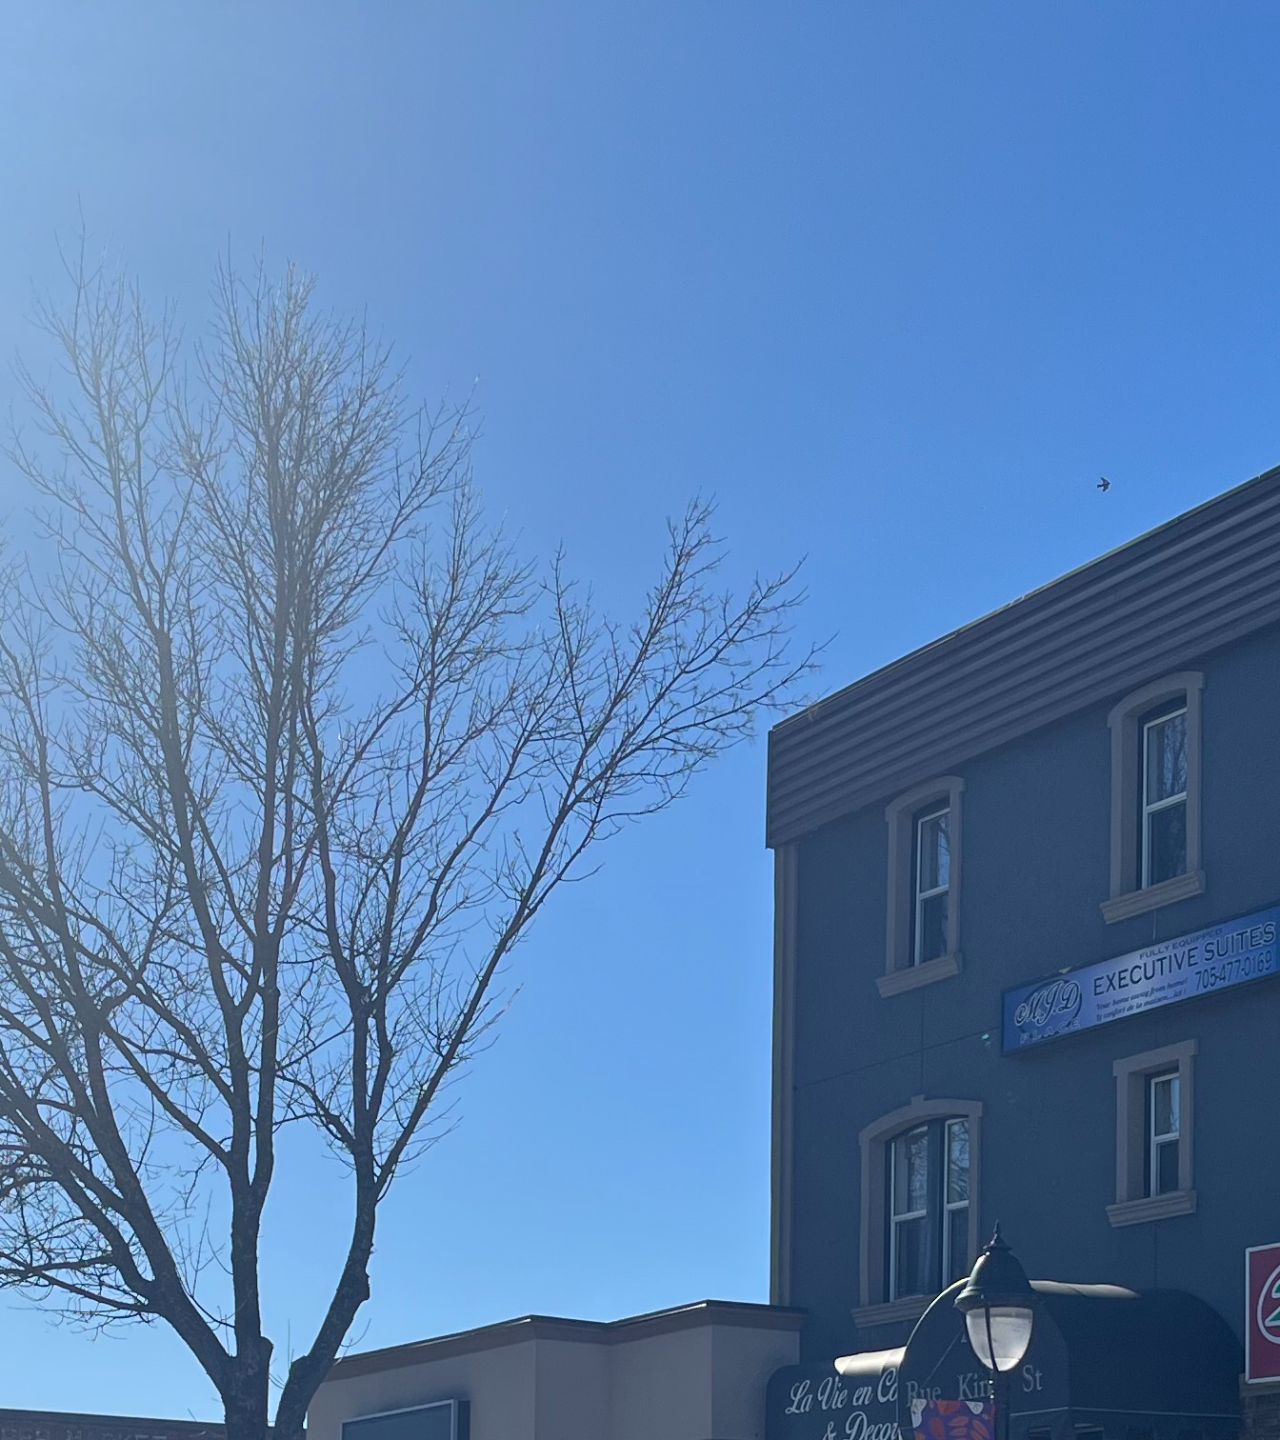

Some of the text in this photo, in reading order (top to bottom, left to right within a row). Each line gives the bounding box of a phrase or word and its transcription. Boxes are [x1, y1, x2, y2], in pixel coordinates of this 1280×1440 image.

[1093, 922, 1277, 997] EXECUTIVE SUITES
[1194, 951, 1273, 992] 705-477-0169
[785, 1380, 813, 1414] La
[818, 1376, 849, 1410] Vie
[853, 1386, 874, 1406] en
[957, 1373, 994, 1400] Kin
[1023, 1365, 1043, 1392] St
